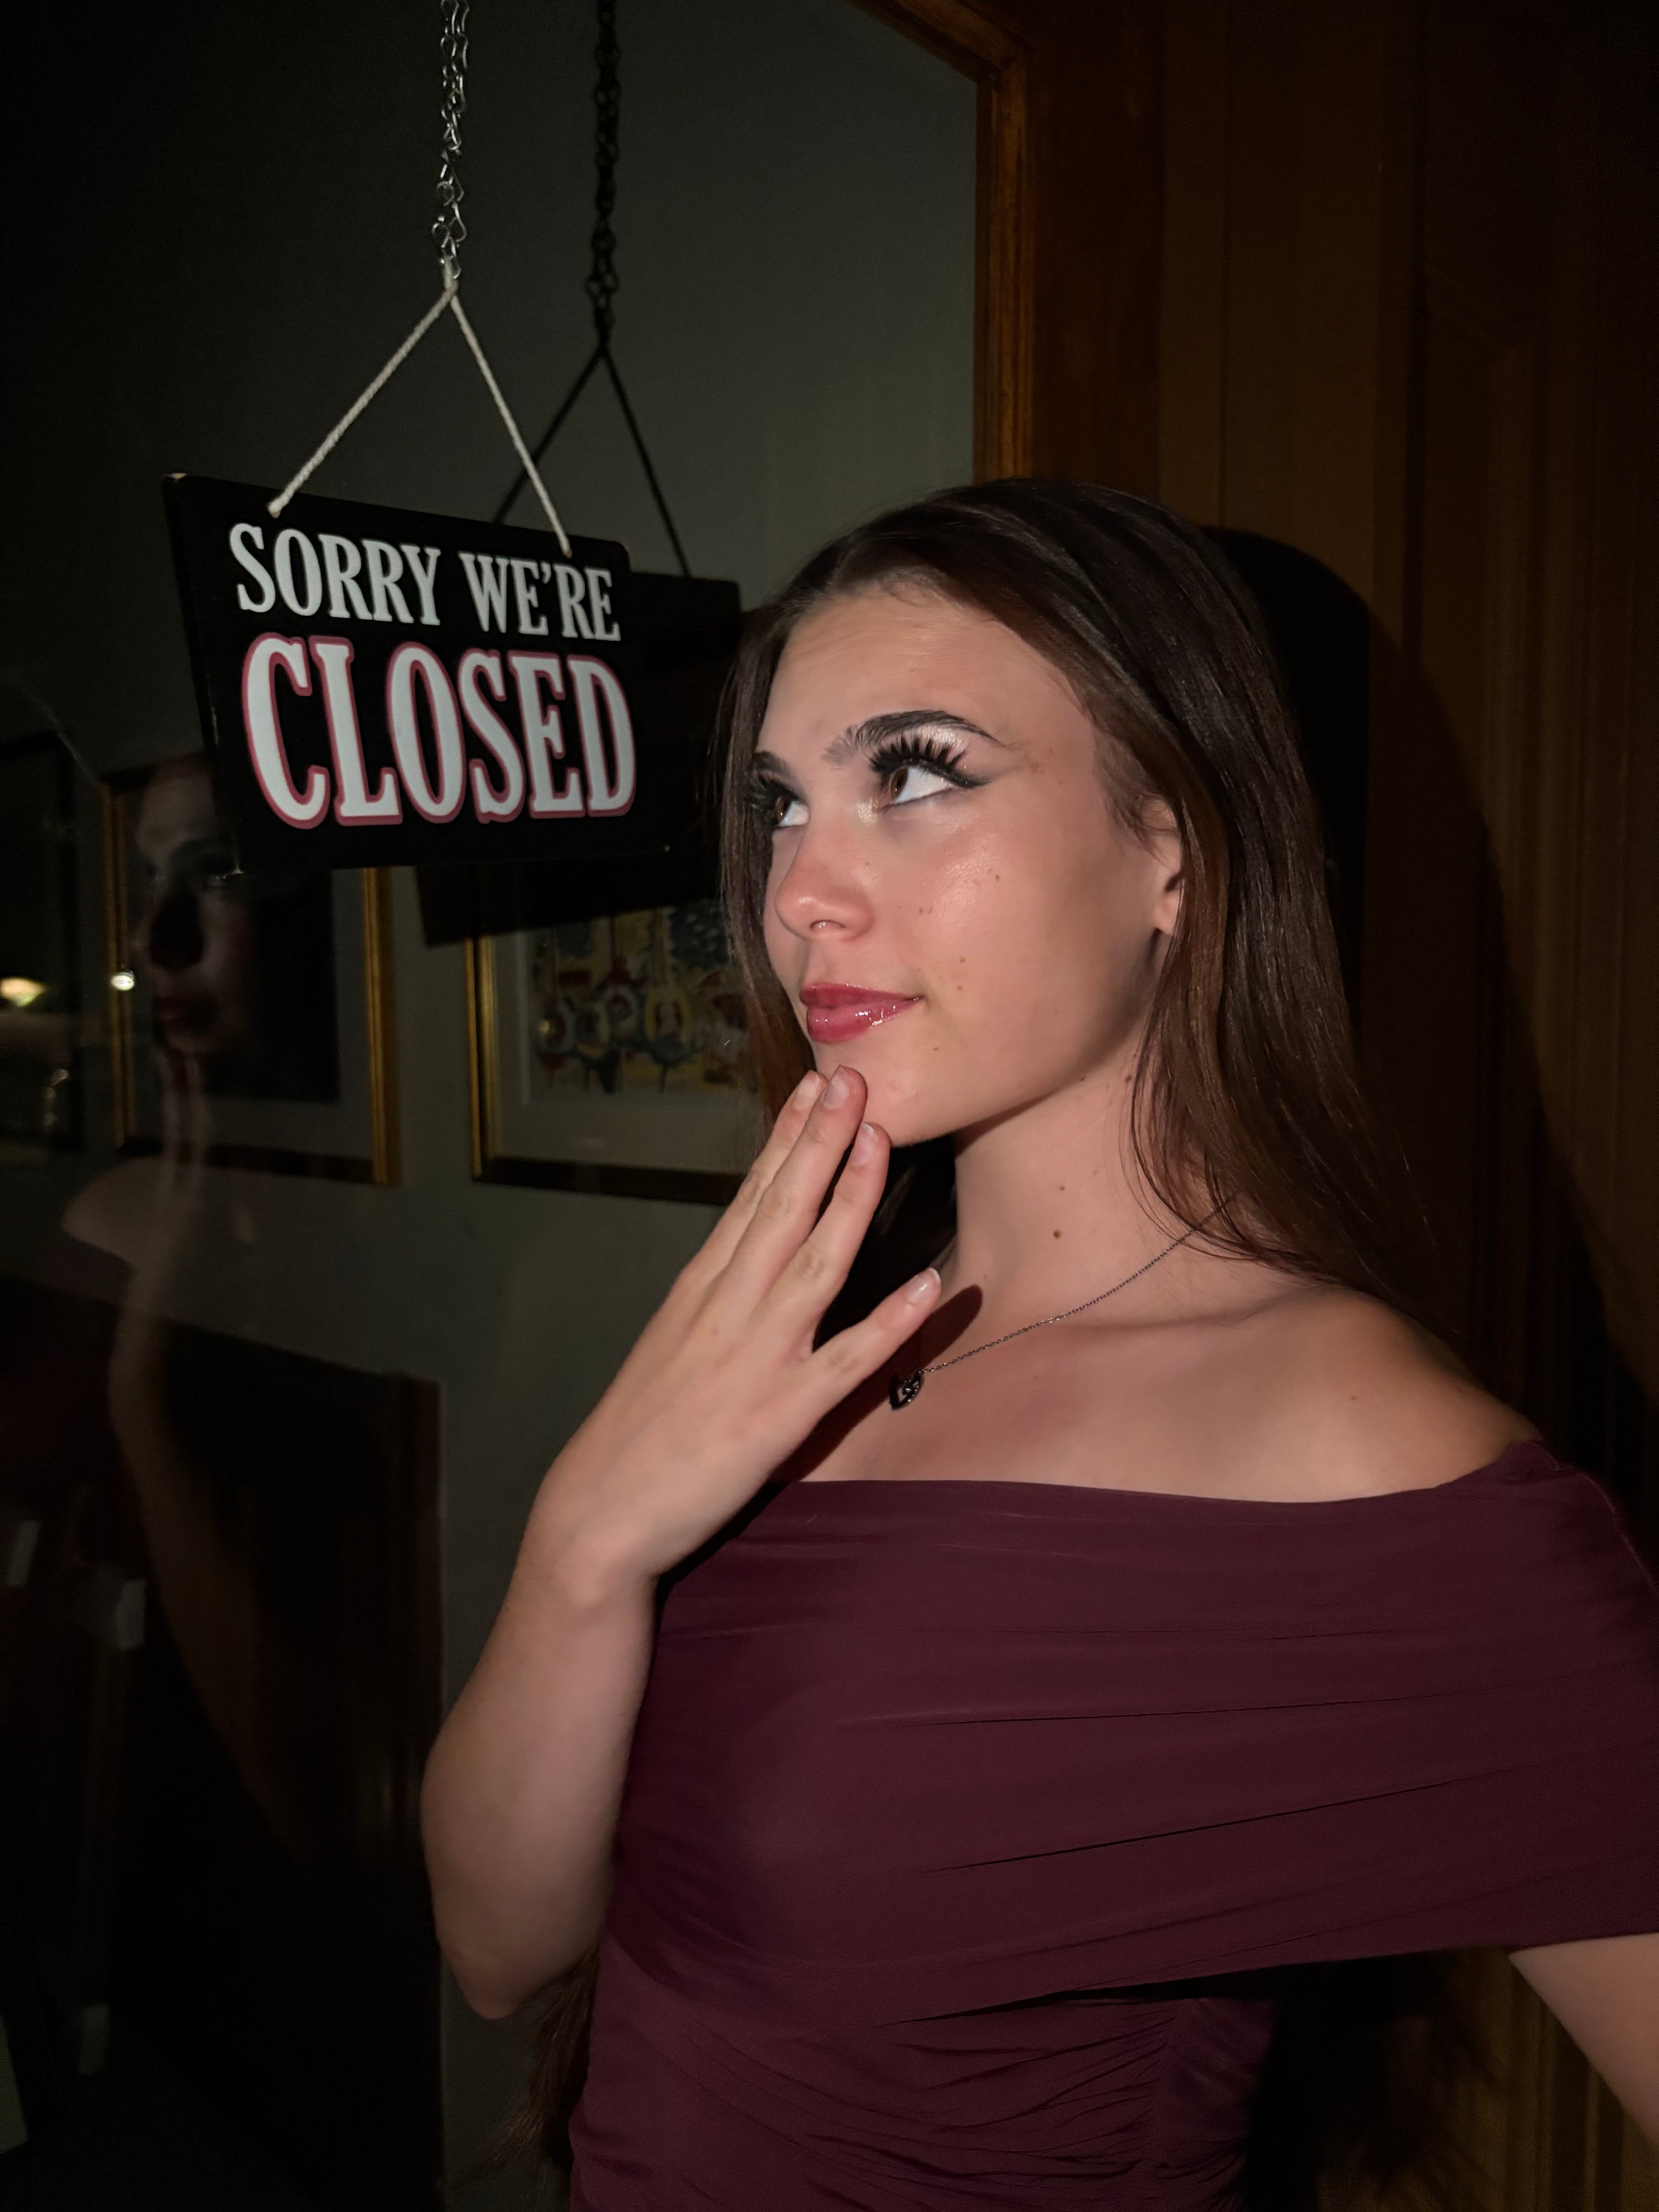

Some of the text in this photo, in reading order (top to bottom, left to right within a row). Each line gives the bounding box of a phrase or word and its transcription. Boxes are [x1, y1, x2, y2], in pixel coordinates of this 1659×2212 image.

[229, 523, 621, 641] SORRY WE'RE
[242, 632, 637, 829] CLOSED
